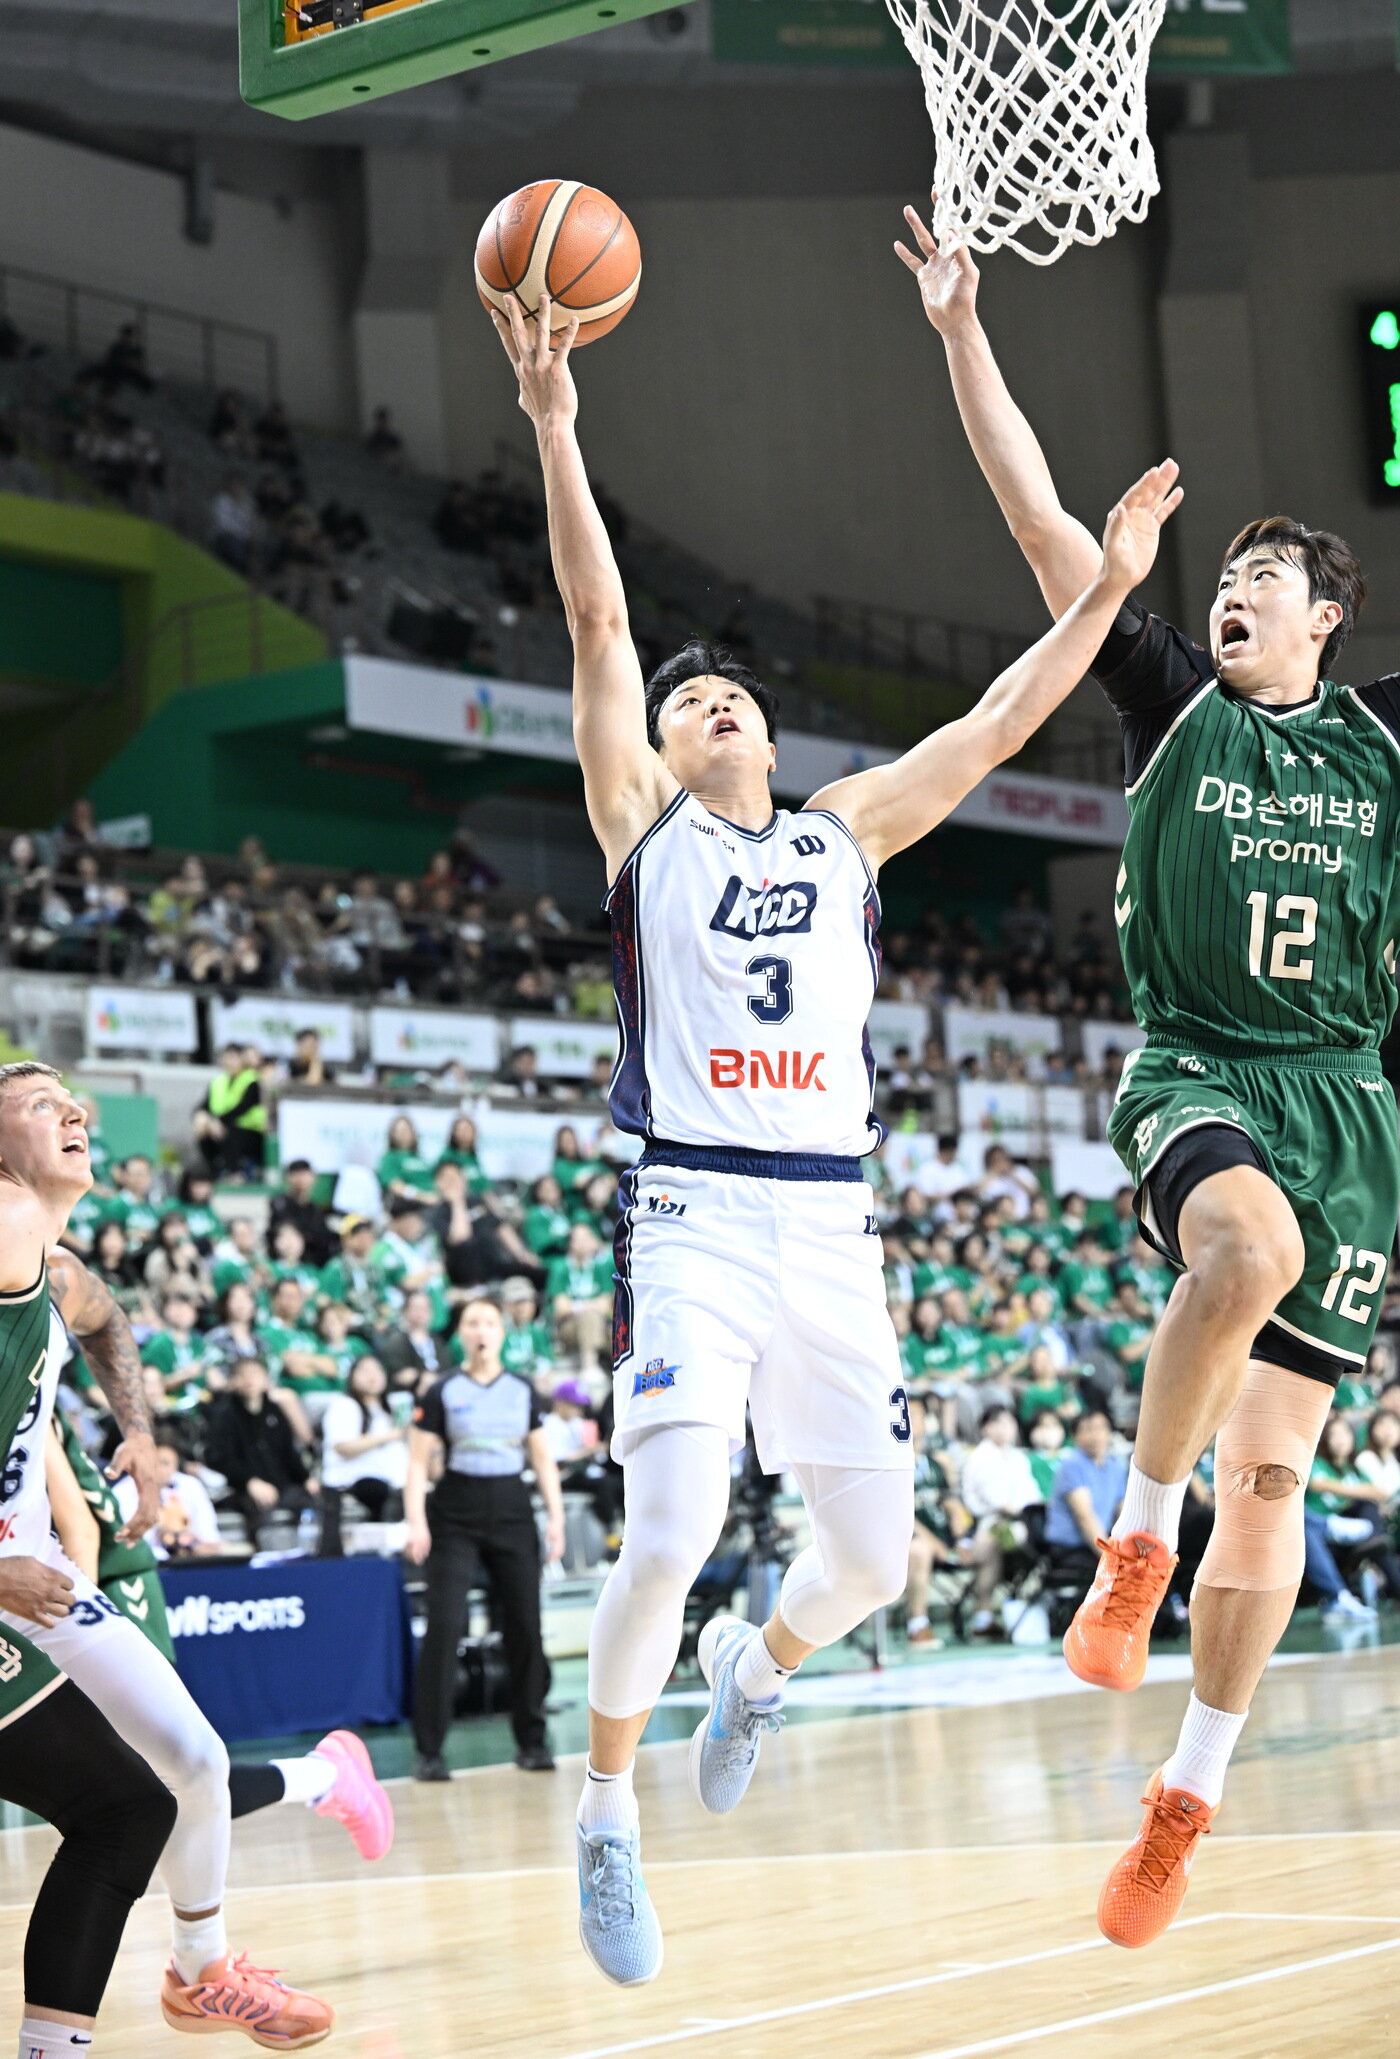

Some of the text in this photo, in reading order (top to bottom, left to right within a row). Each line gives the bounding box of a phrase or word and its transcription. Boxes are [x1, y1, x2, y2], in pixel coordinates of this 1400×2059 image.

[1231, 834, 1342, 873] promy
[1246, 890, 1319, 981] 12
[745, 954, 794, 1025] 3
[709, 1048, 827, 1091] BNK
[1320, 1244, 1387, 1325] 12
[889, 1385, 911, 1443] 3
